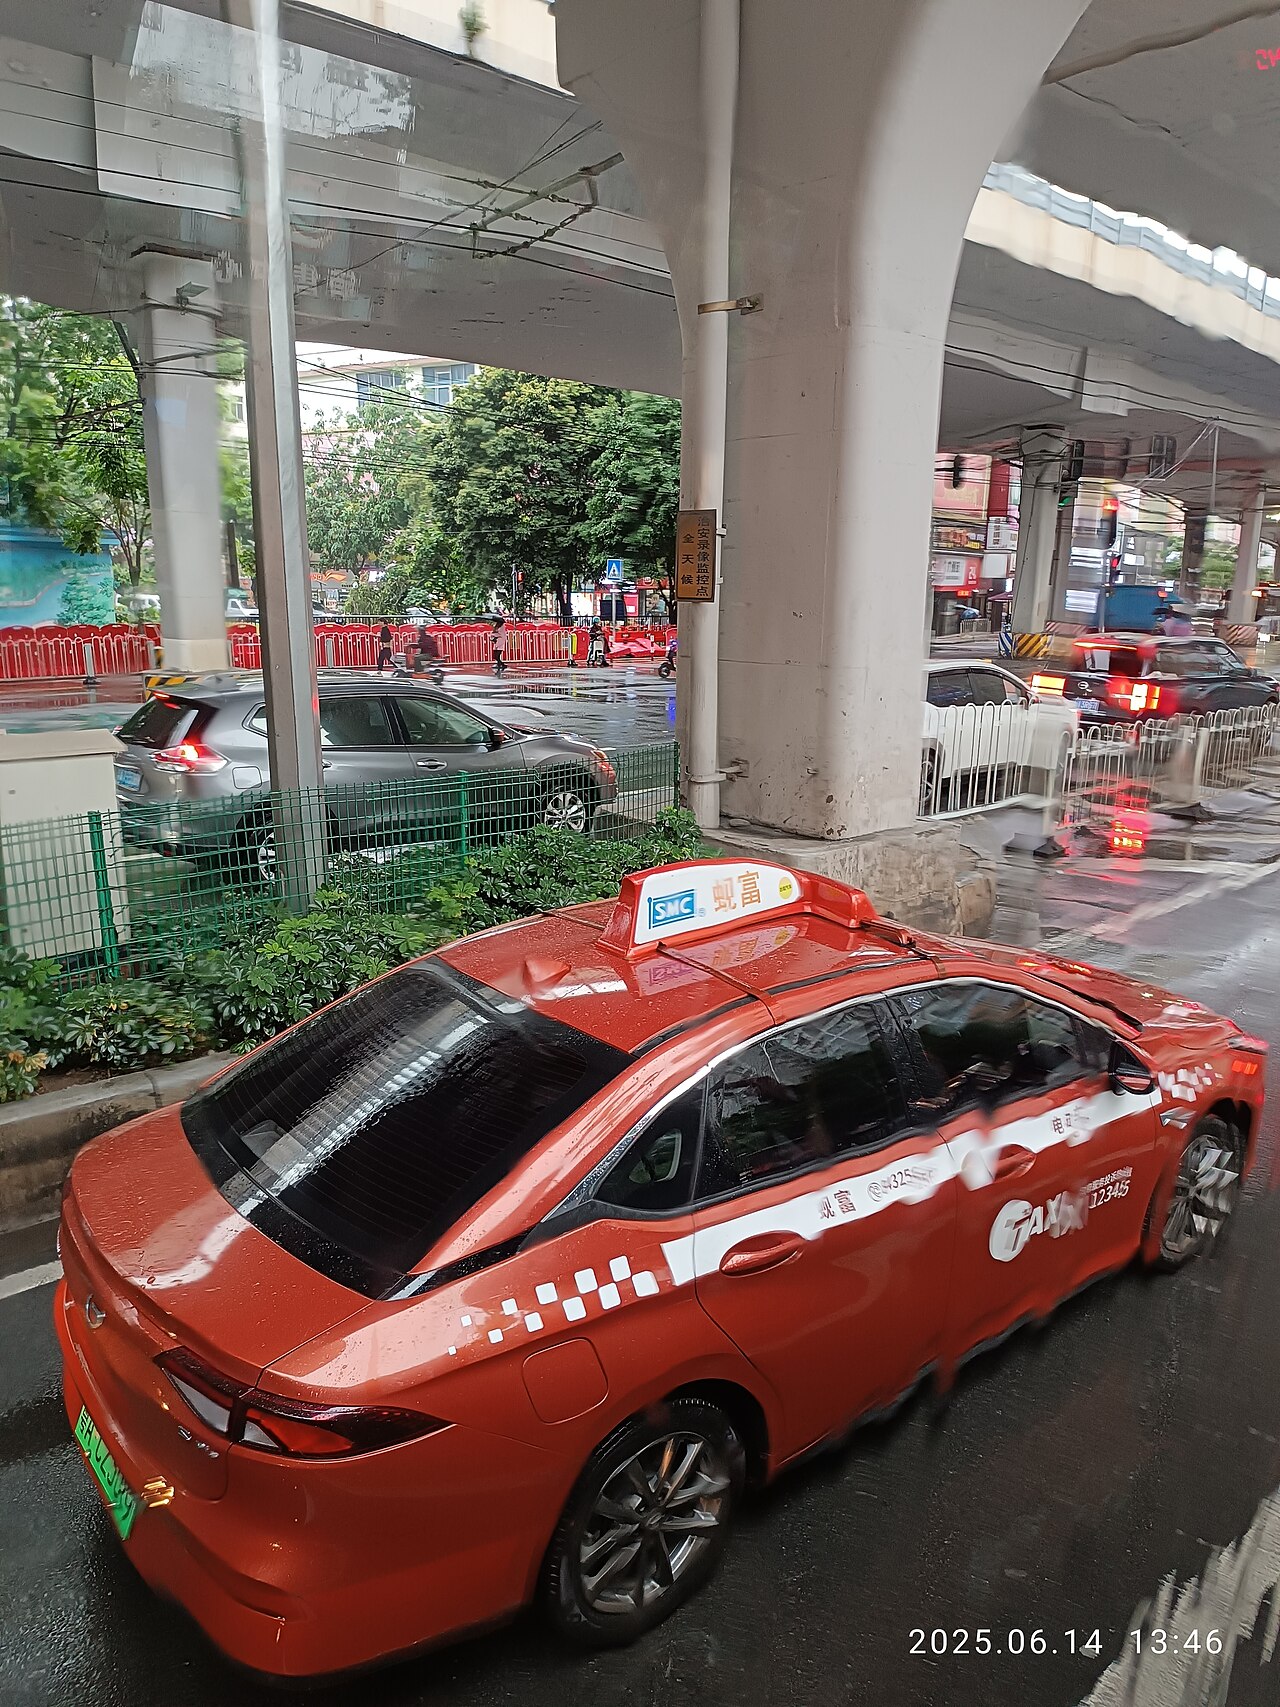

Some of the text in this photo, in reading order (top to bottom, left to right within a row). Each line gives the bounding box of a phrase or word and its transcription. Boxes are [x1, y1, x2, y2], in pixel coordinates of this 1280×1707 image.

[681, 533, 694, 585] 全天候
[654, 896, 693, 921] SMC
